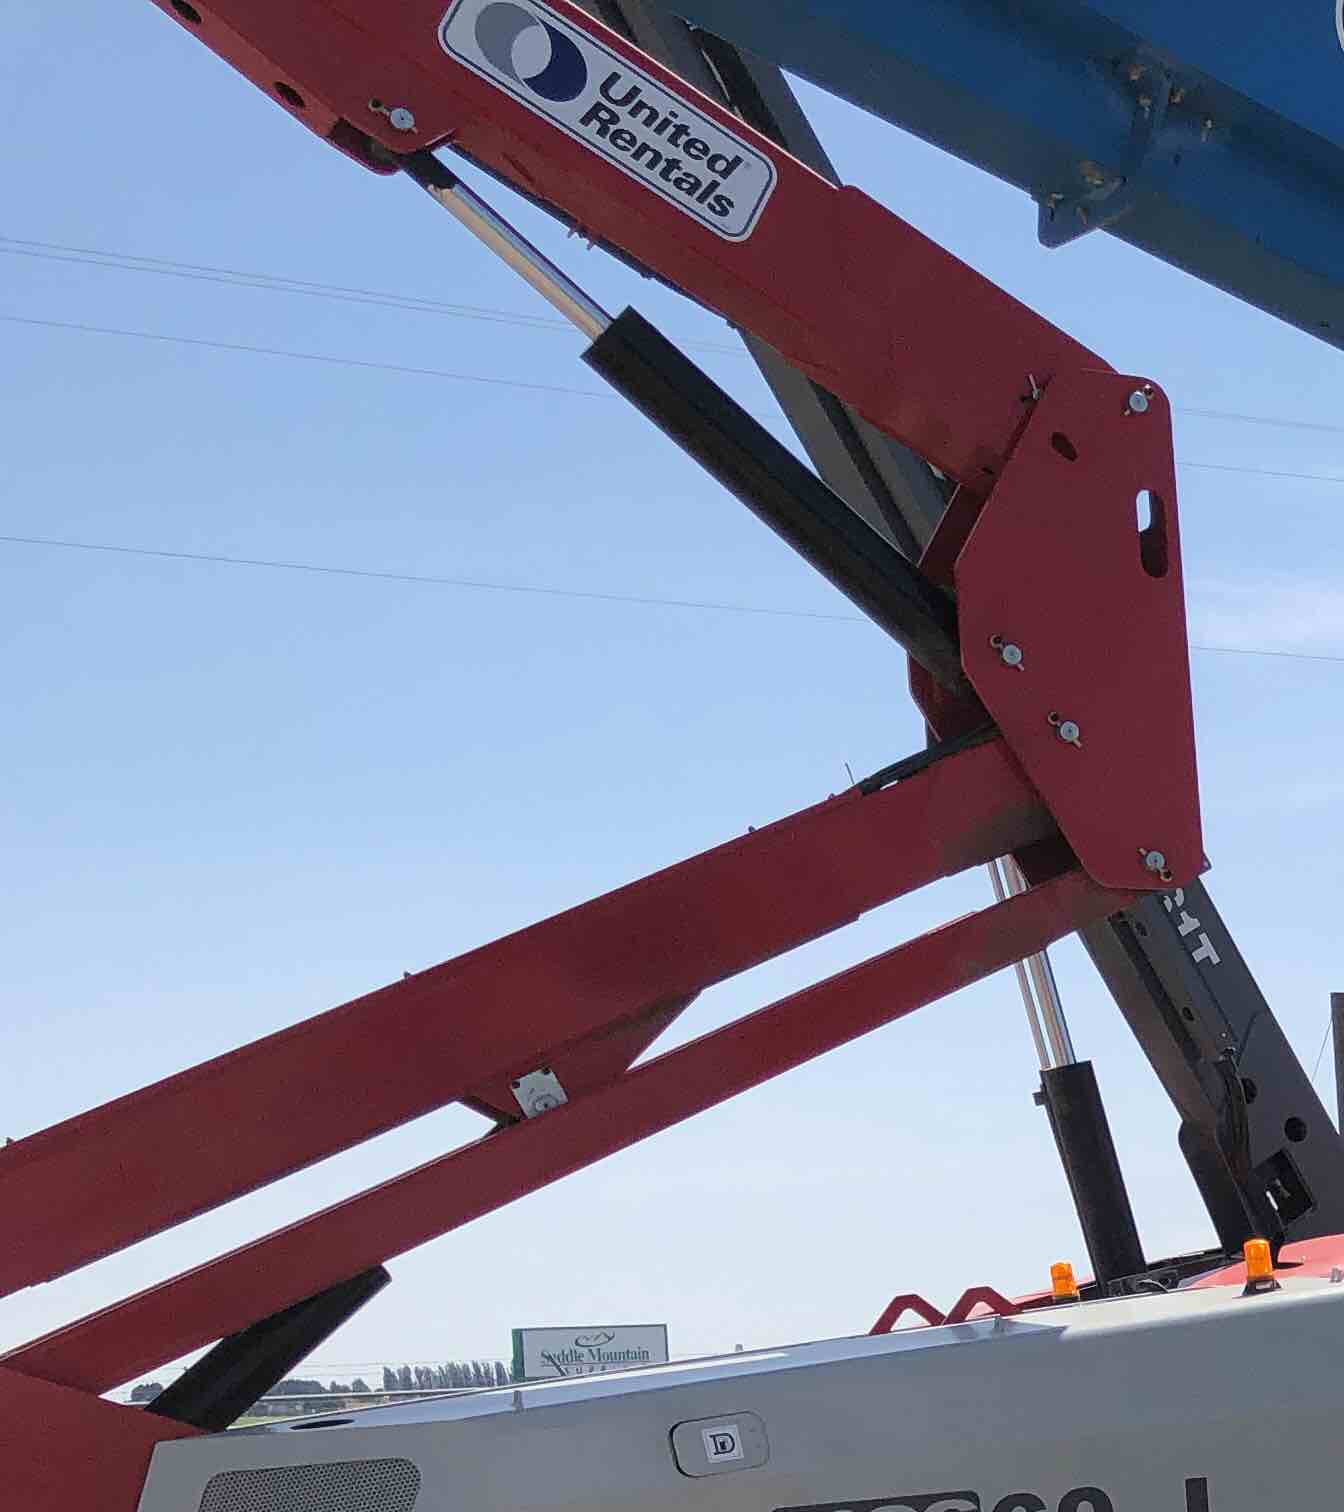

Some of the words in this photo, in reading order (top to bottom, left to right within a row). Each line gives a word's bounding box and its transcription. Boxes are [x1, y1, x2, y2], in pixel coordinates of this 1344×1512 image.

[578, 101, 735, 217] Rentals
[600, 71, 744, 180] United
[589, 1346, 650, 1362] Mountain
